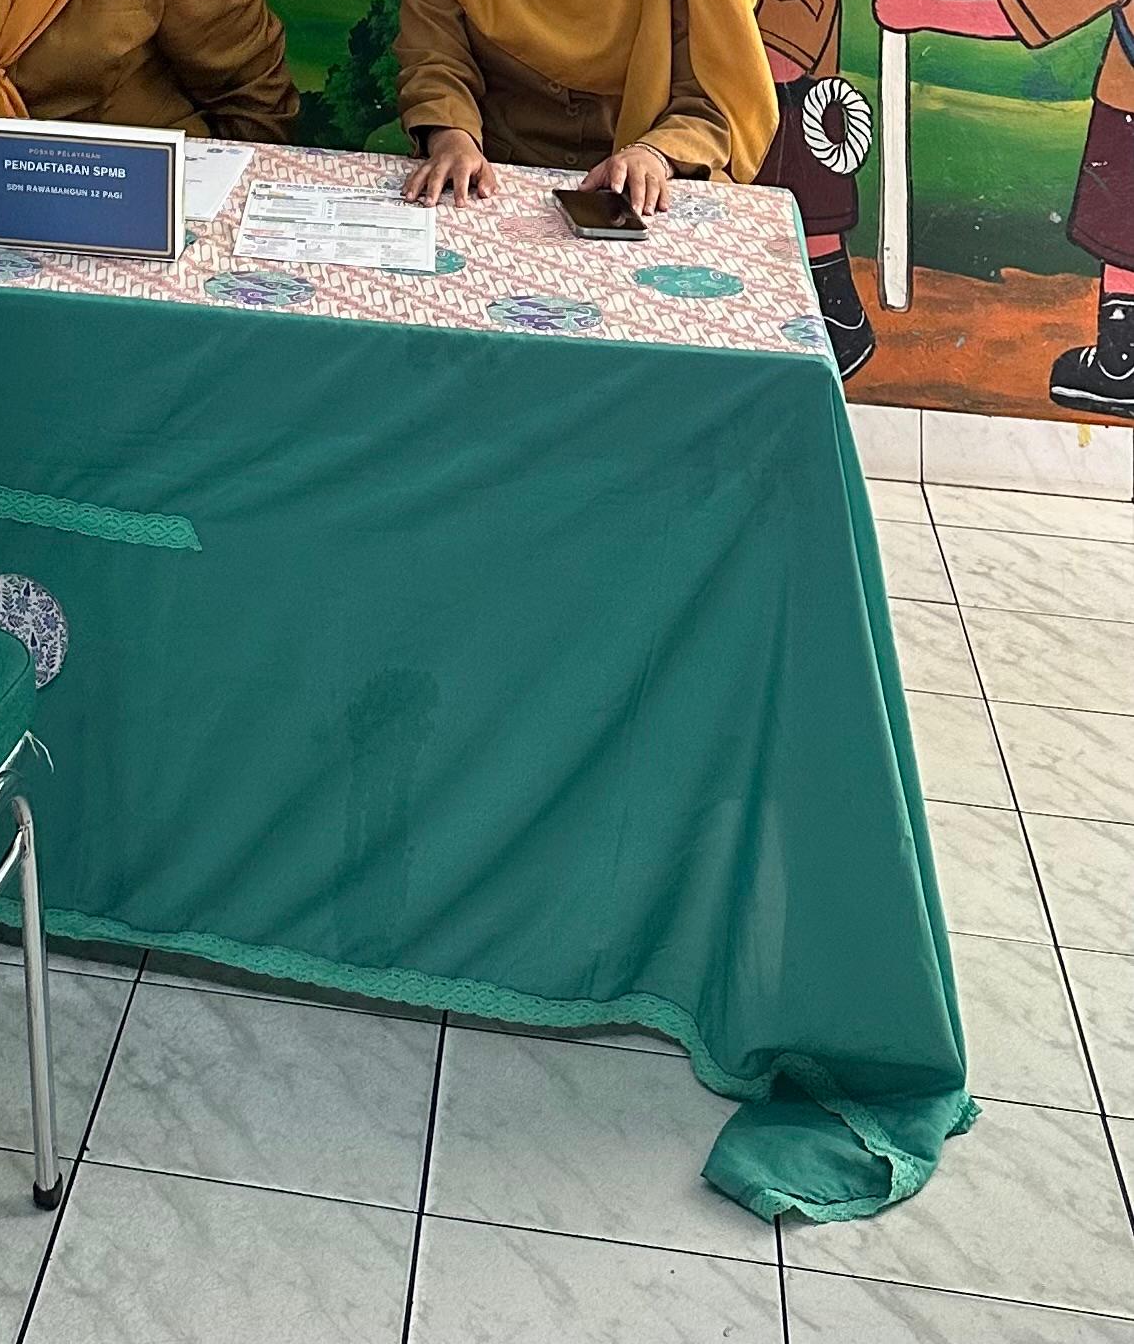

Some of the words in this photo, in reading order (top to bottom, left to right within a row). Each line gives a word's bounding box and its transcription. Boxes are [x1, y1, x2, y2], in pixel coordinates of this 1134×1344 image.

[4, 159, 90, 176] PENDAFTARAN
[93, 165, 126, 179] SPMB
[6, 183, 24, 192] SDN
[26, 184, 88, 197] RAWAMANGUN
[90, 189, 100, 198] 12
[102, 190, 123, 200] PAGI
